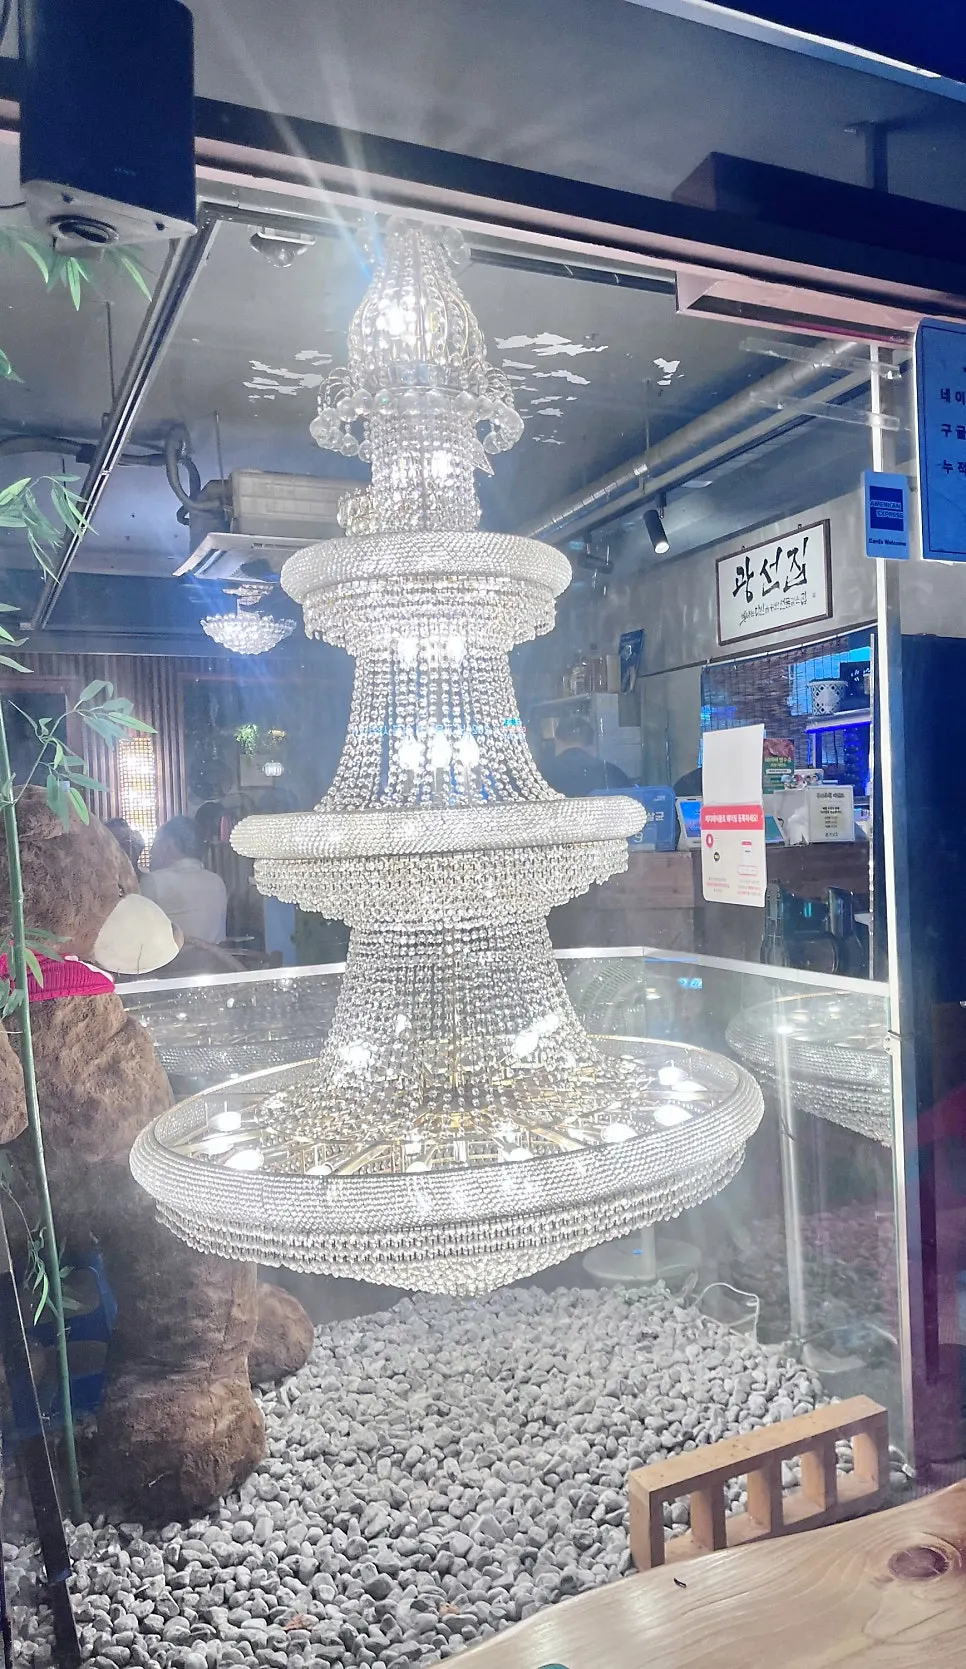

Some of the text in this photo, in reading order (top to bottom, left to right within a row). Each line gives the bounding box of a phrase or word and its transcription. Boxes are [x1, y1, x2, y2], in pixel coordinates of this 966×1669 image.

[870, 500, 902, 510] AMERICAN
[876, 510, 904, 519] EXPRESS
[884, 539, 907, 547] Welcome
[732, 536, 809, 603] 광선집
